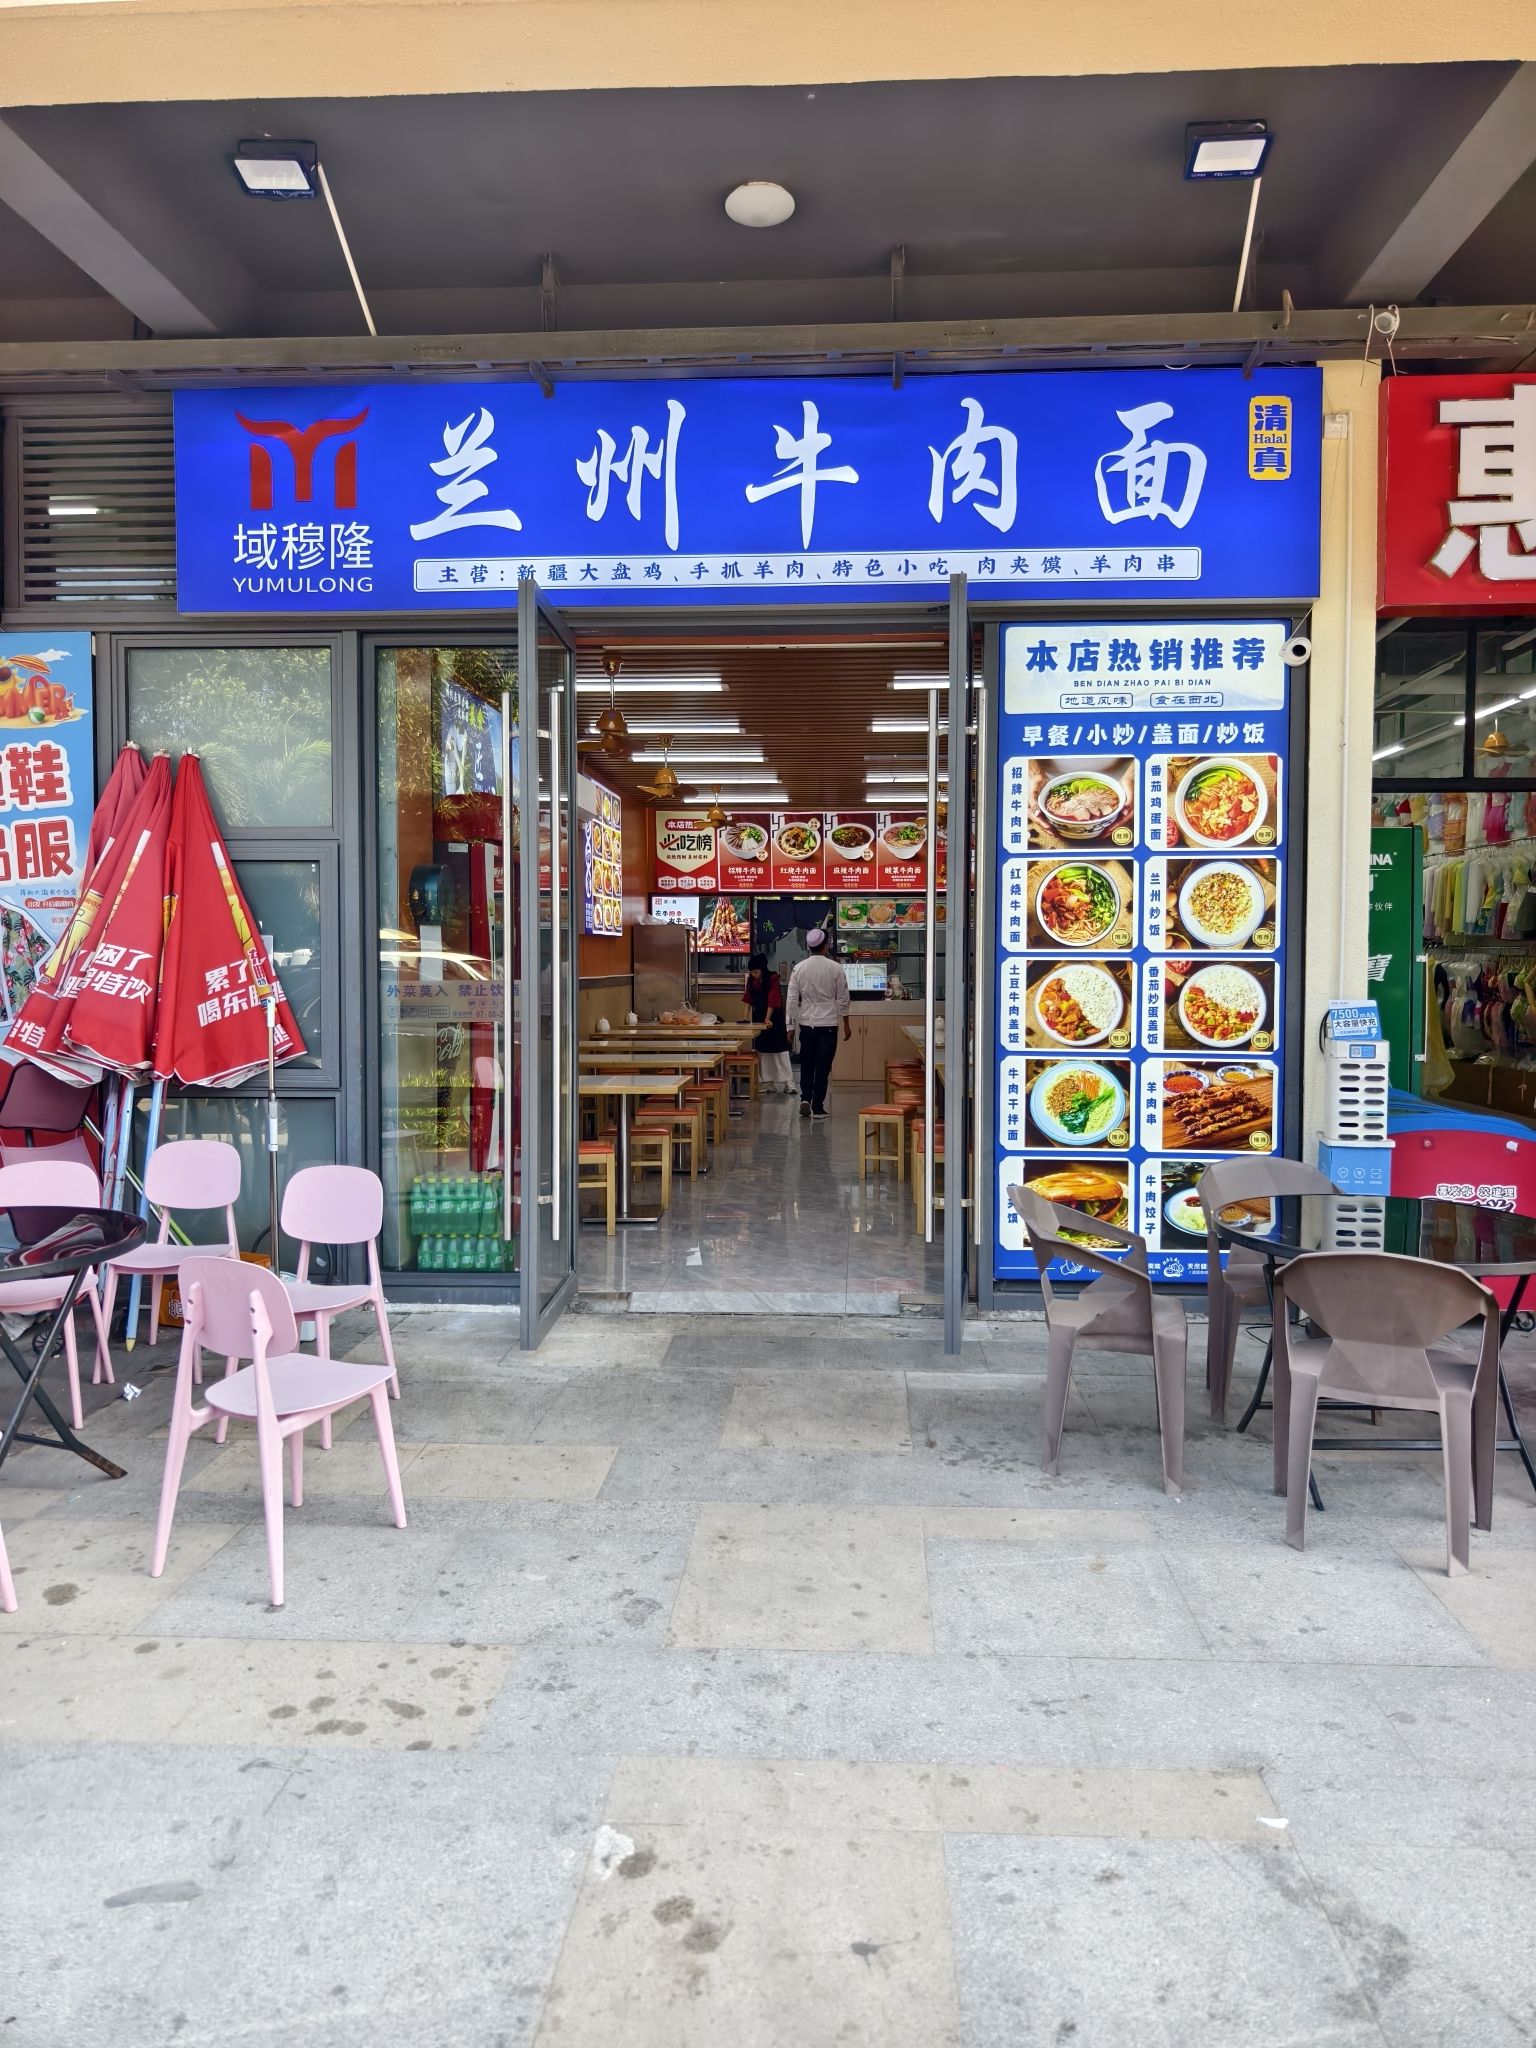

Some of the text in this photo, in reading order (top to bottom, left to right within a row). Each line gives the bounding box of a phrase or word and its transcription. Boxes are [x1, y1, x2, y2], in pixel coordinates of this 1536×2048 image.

[1254, 405, 1287, 431] 清
[1254, 433, 1287, 444] Halal
[410, 397, 1207, 550] 兰州牛肉面
[1253, 446, 1287, 473] 真
[233, 521, 374, 570] 域穆隆
[233, 576, 373, 593] YUMULONG
[438, 554, 1176, 583] 主营：新疆大盘鸡、手抓羊肉、特色小吃肉夹馍、羊肉串
[1025, 637, 1267, 673] 本店热销推荐
[1065, 696, 1128, 706] 地道风味
[1074, 678, 1212, 688] BEN DIAN ZHAO PAI BI DIAN
[1022, 722, 1266, 748] 早餐/小炒/盖面/炒饭
[0, 743, 68, 806] 鞋
[1011, 766, 1023, 845] 招牌牛肉面
[1150, 765, 1163, 841] 番茄鸡蛋面
[1009, 868, 1022, 943] 红烧牛肉面
[1149, 872, 1161, 937] 兰州炒饭
[387, 984, 448, 997] 外菜莫入
[1008, 964, 1020, 1044] 土豆牛肉盖饭
[1147, 966, 1160, 1045] 番茄炒蛋盖饭
[1332, 1009, 1358, 1019] 7500
[1334, 1018, 1376, 1028] 大容量快充
[1007, 1068, 1019, 1142] 牛肉干拌面
[1146, 1082, 1157, 1125] 羊肉串
[1144, 1175, 1157, 1234] 牛肉饺子
